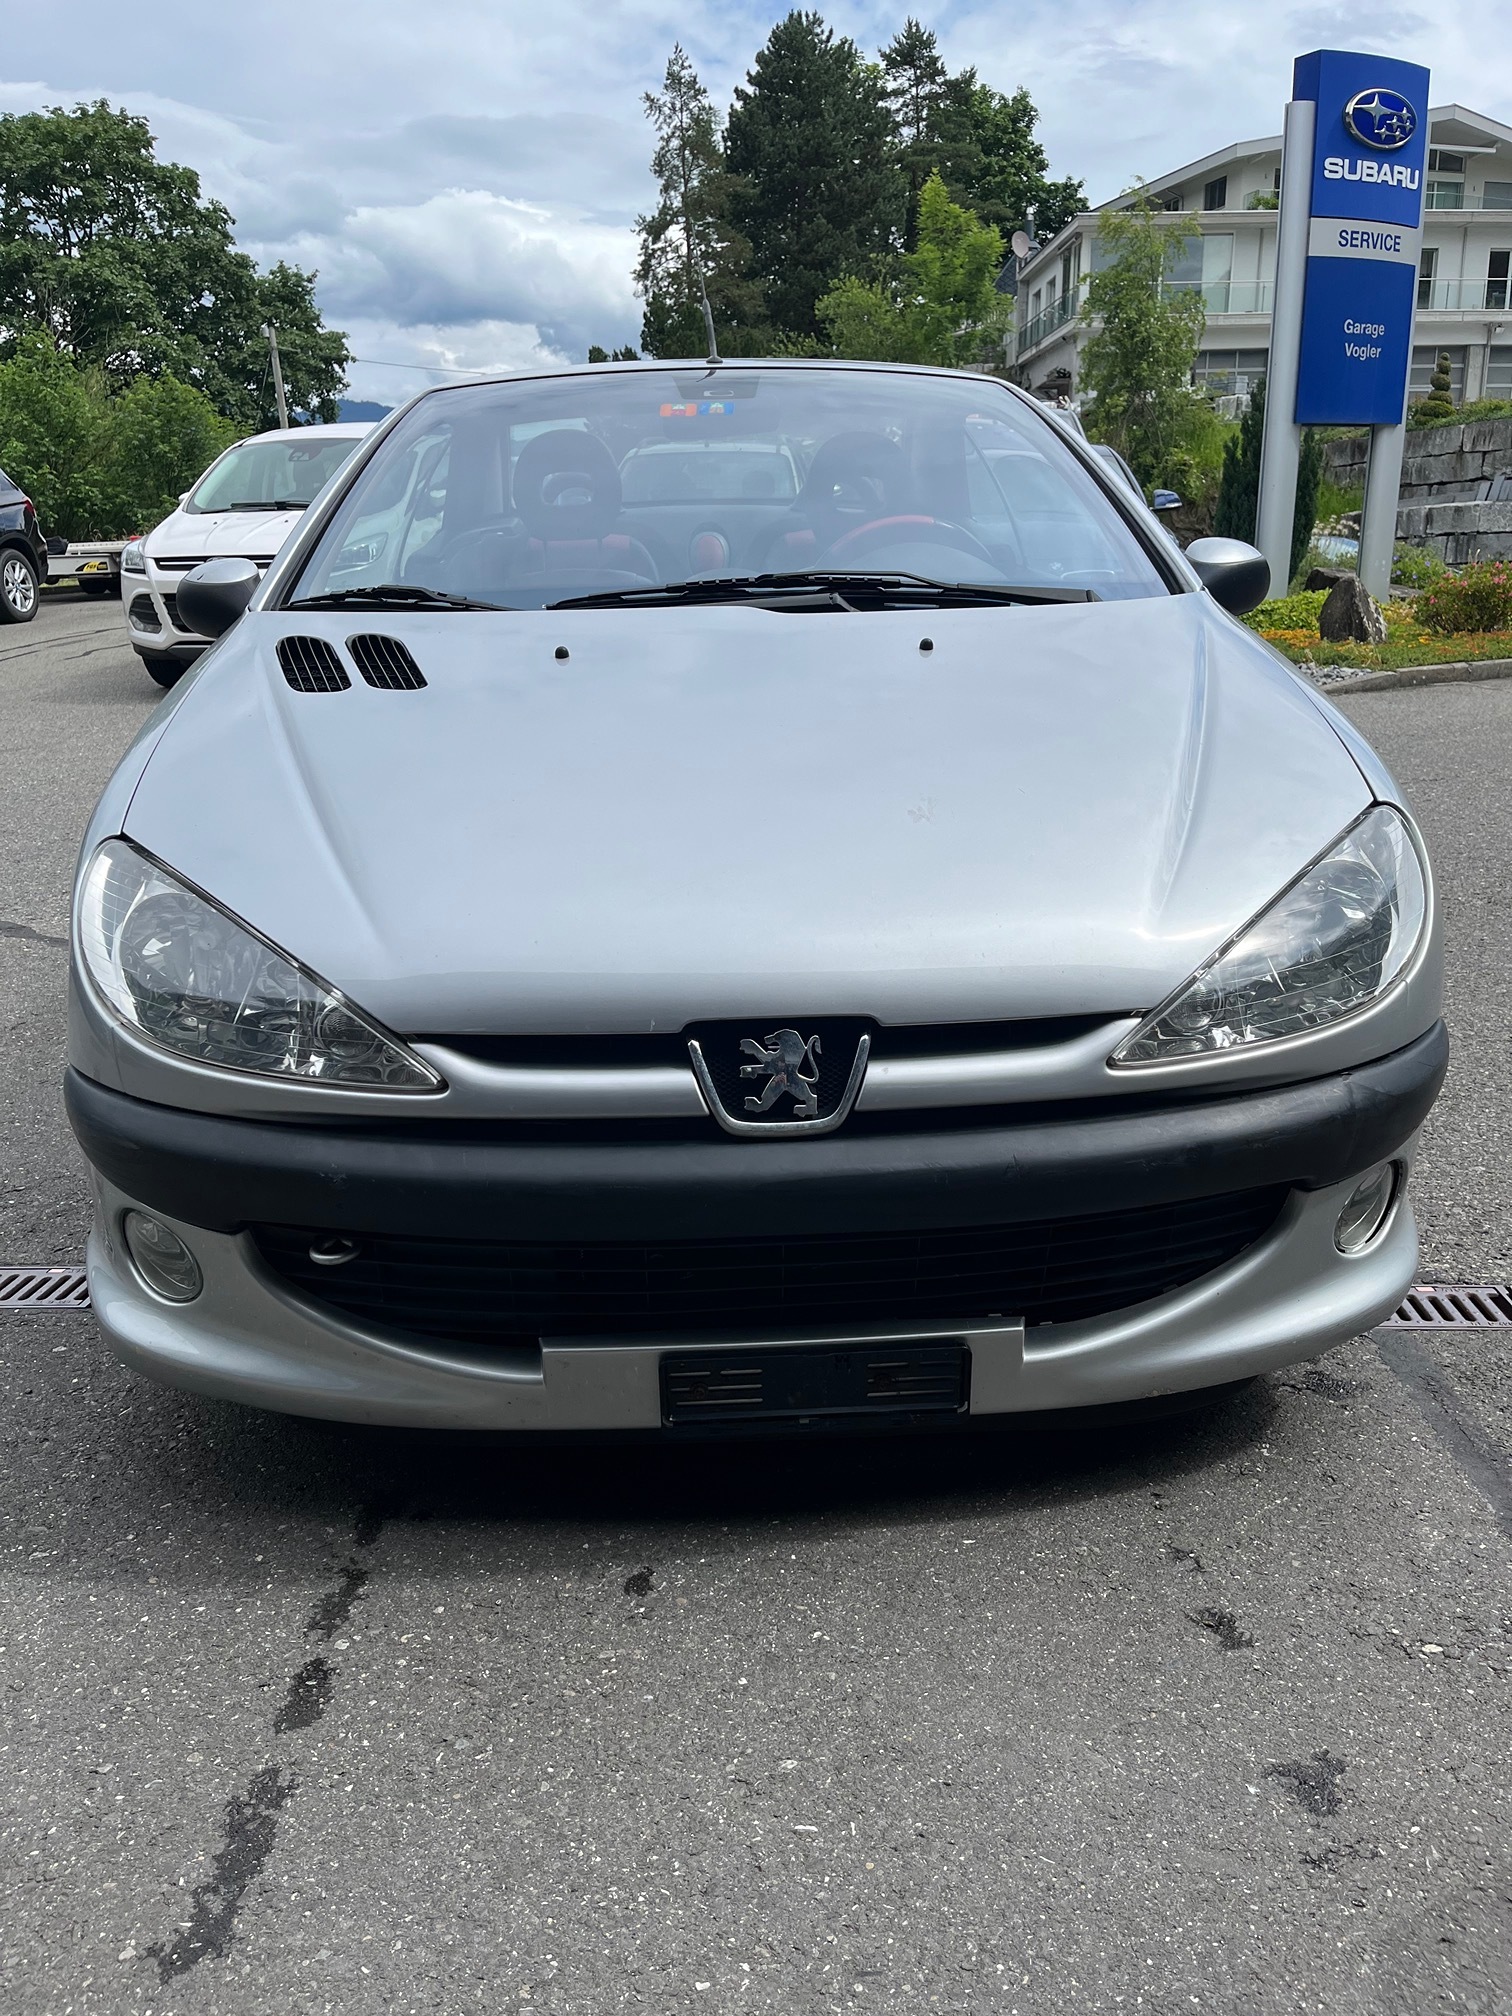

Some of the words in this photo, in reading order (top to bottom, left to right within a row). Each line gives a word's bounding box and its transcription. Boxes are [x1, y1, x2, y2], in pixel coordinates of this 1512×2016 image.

[1324, 157, 1420, 190] SUBARU
[1338, 229, 1402, 252] SERVICE
[1343, 319, 1385, 338] Garage
[1344, 342, 1382, 361] Vogler
